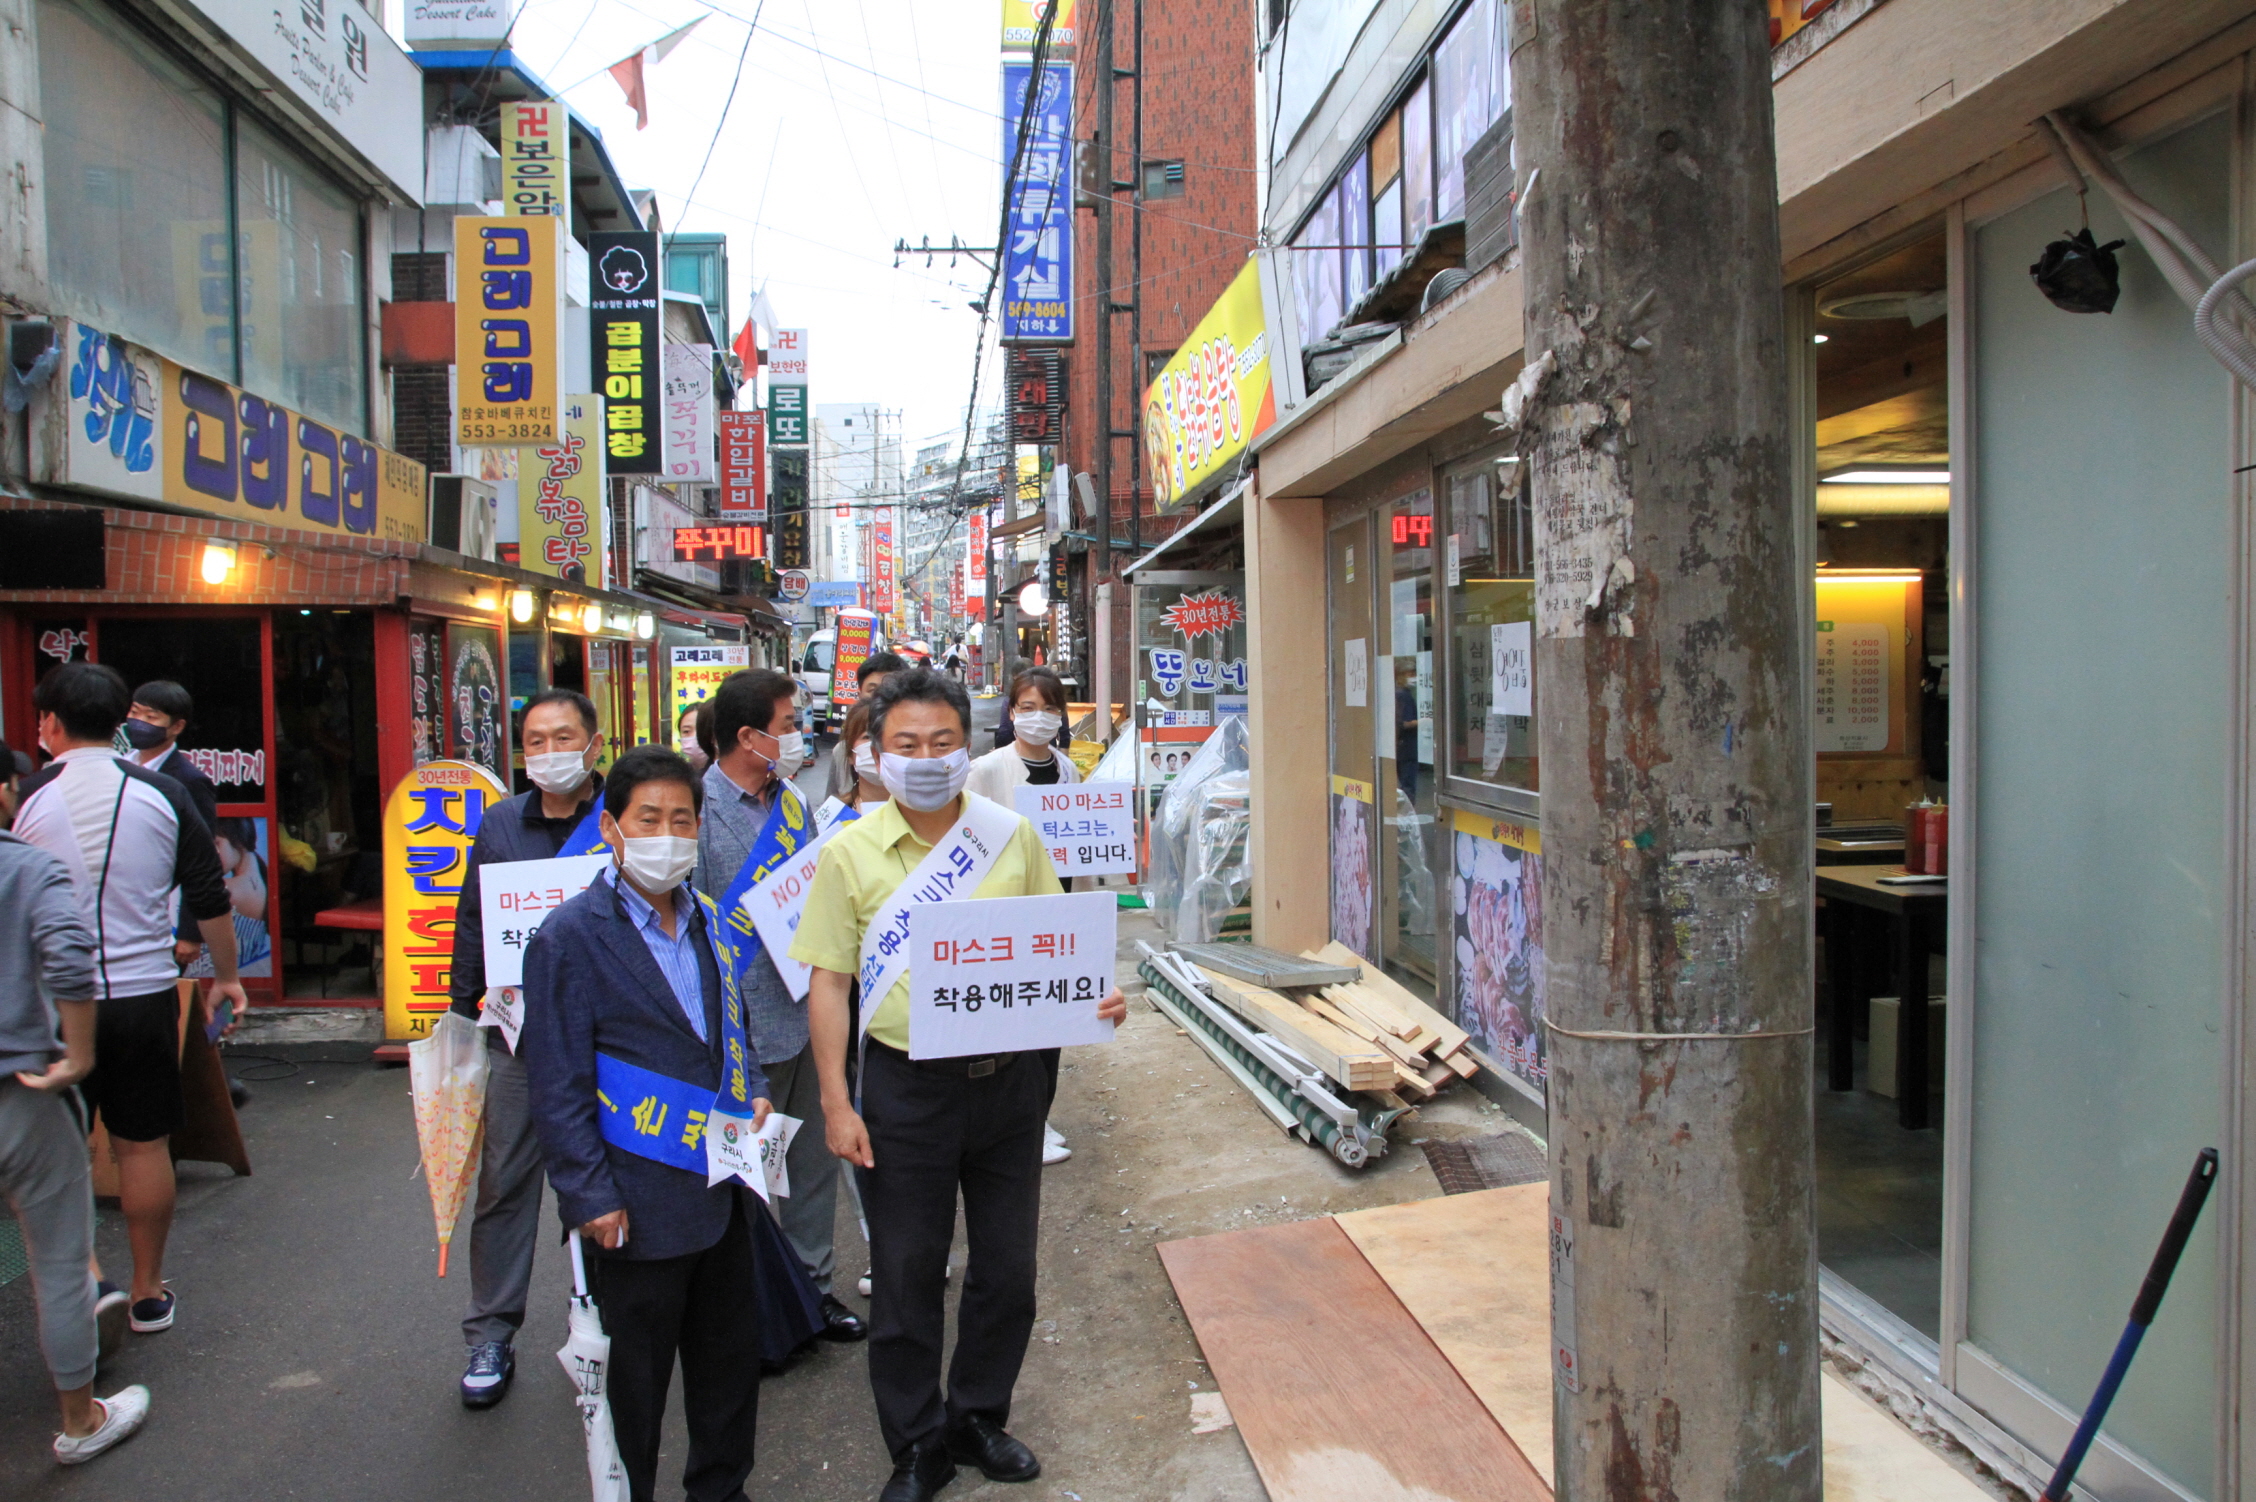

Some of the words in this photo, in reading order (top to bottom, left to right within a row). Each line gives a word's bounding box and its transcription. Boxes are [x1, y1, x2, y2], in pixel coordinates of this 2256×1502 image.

[415, 6, 461, 20] Dessert
[465, 5, 496, 21] Cake
[510, 140, 557, 215] 보은암
[480, 226, 532, 402] 고래고래
[1008, 301, 1066, 317] 569-8604
[769, 359, 808, 374] 보현암
[605, 321, 647, 457] 곱분이곱창
[461, 406, 551, 420] 참숯바베큐치킨
[721, 414, 761, 425] 마포
[774, 388, 802, 440] 로또
[462, 424, 552, 438] 553-3824
[180, 369, 380, 538] 고래고래
[728, 426, 756, 508] 한입갈비
[674, 526, 763, 560] 쭈꾸미
[783, 577, 807, 590] 담배
[1182, 604, 1232, 625] 30년전통
[1852, 639, 1880, 648] 4,000
[675, 649, 724, 662] 고래고래
[727, 646, 744, 655] 30년
[728, 656, 744, 664] 전통
[1852, 649, 1880, 658] 4,000
[1153, 652, 1248, 692] 뚱보네
[1852, 659, 1880, 667] 3,000
[1852, 669, 1880, 677] 5,000
[1852, 678, 1880, 686] 5,000
[1851, 687, 1880, 696] 8,000
[1851, 697, 1880, 705] 8,000
[1847, 706, 1880, 715] 10,000
[1851, 716, 1880, 724] 2,000
[417, 768, 472, 785] 30년전통
[1041, 793, 1070, 811] NO
[1075, 793, 1125, 811] 마스크
[1042, 819, 1115, 839] 턱스크는,
[970, 835, 989, 859] 구리시
[1077, 843, 1132, 865] 입니다.
[912, 845, 975, 903] 마스크
[771, 874, 802, 909] NO
[800, 860, 819, 882] 마
[499, 888, 565, 913] 마스크
[878, 908, 910, 957] 착용
[933, 938, 1015, 967] 마스크
[1031, 932, 1076, 959] 꼭!!
[932, 976, 1106, 1015] 착용해주세요!
[495, 1000, 512, 1019] 구리시
[714, 939, 741, 1029] 마스크
[728, 1037, 748, 1103] 착용
[721, 1142, 744, 1160] 구리시
[767, 1137, 779, 1170] 구리시
